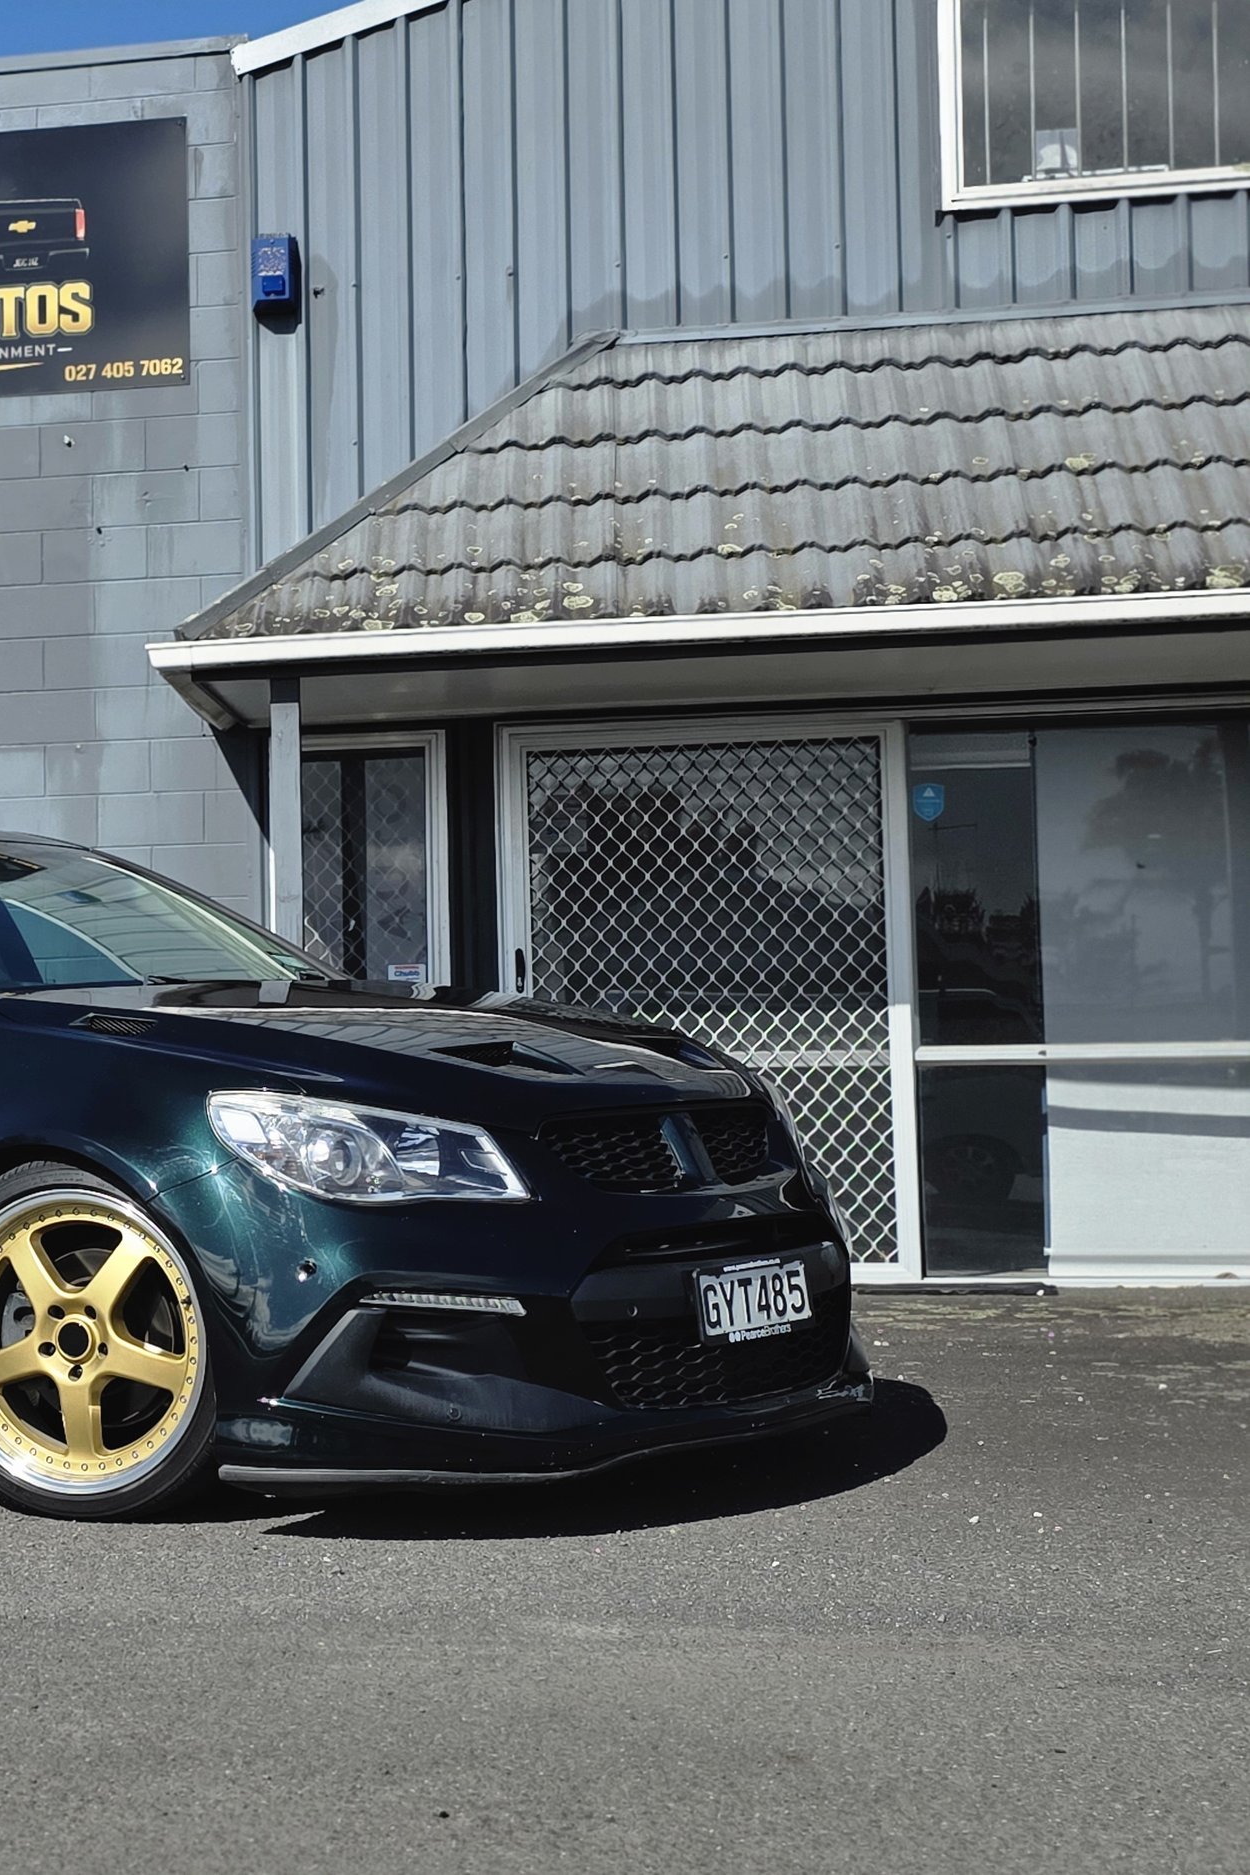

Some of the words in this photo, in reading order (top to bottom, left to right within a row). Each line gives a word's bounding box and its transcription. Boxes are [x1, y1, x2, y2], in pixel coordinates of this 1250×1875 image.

[64, 364, 97, 382] 027
[101, 361, 135, 379] 405
[139, 357, 184, 376] 7062
[702, 1269, 806, 1329] GYT485
